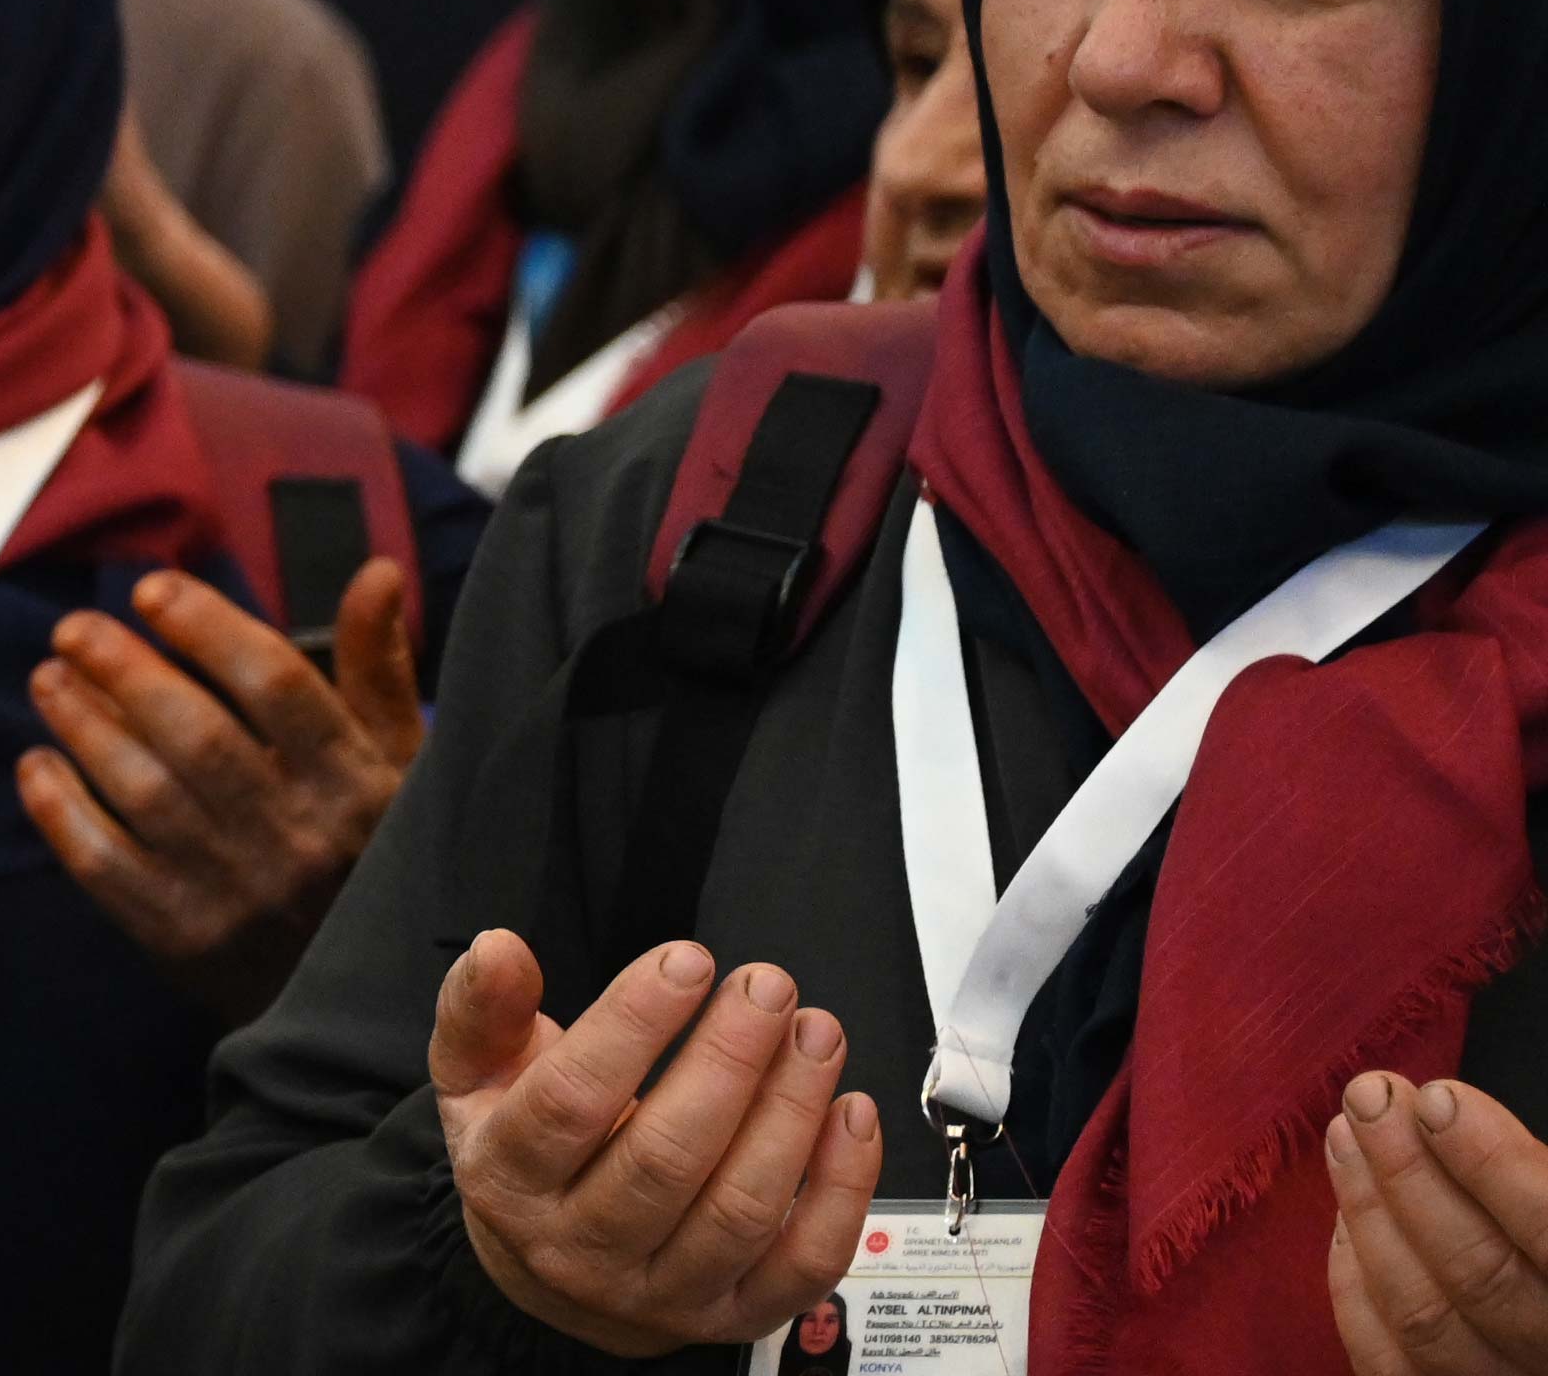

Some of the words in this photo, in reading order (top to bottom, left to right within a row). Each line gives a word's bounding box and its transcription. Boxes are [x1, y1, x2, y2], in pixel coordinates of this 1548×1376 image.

[867, 1305, 908, 1315] AYSEL
[917, 1305, 991, 1315] ALTINPINAR
[859, 1363, 903, 1373] KONYA
